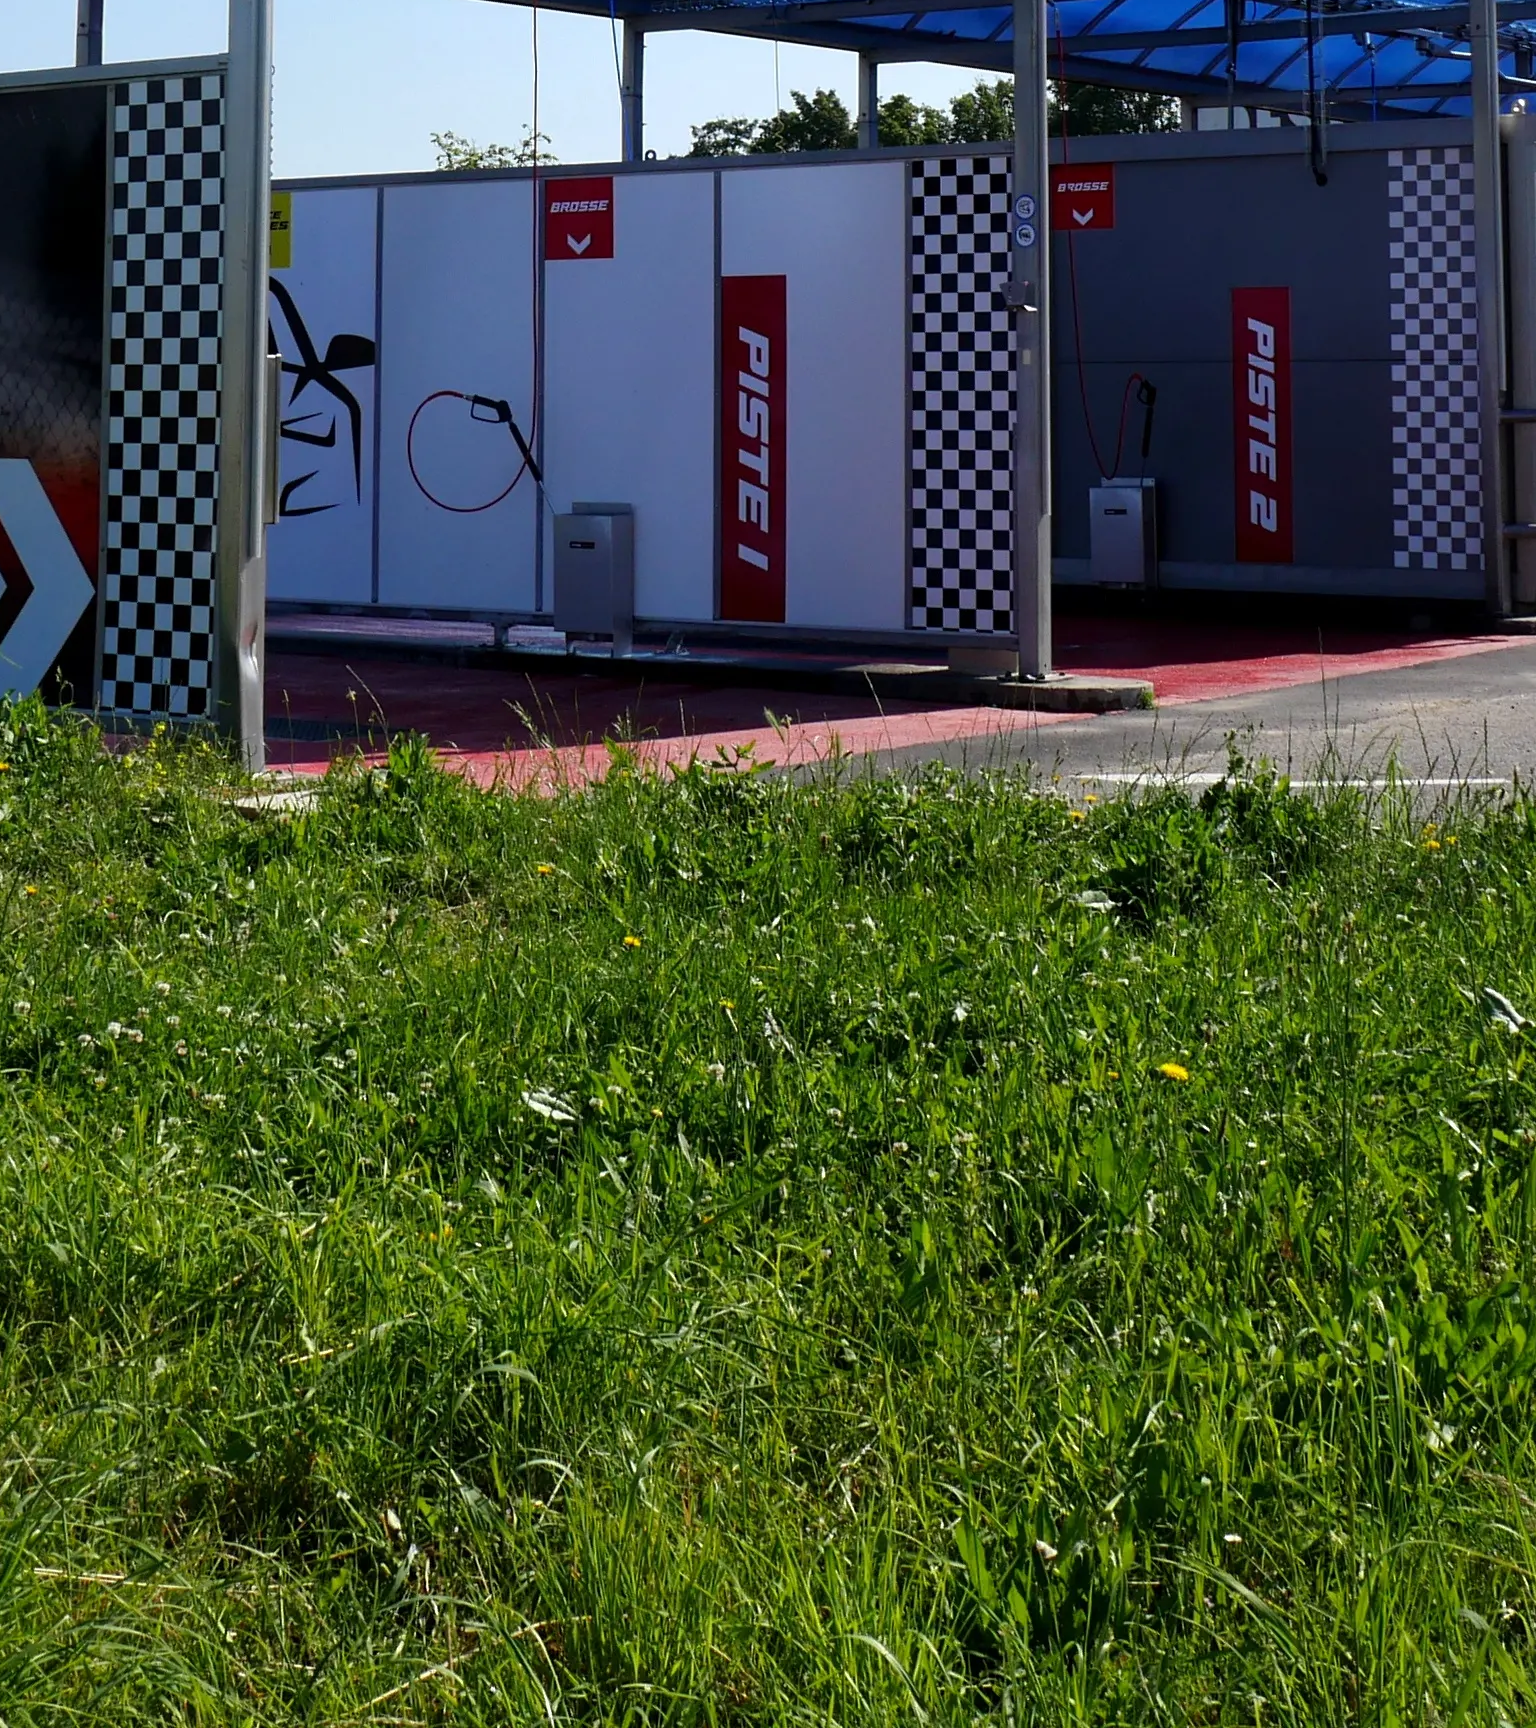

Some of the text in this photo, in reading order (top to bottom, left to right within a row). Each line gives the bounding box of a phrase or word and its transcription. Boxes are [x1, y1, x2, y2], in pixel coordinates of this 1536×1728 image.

[550, 200, 609, 213] BROSSE
[1057, 181, 1109, 193] BROSSE
[737, 325, 769, 533] PISTE
[1247, 317, 1277, 533] PISTE 2
